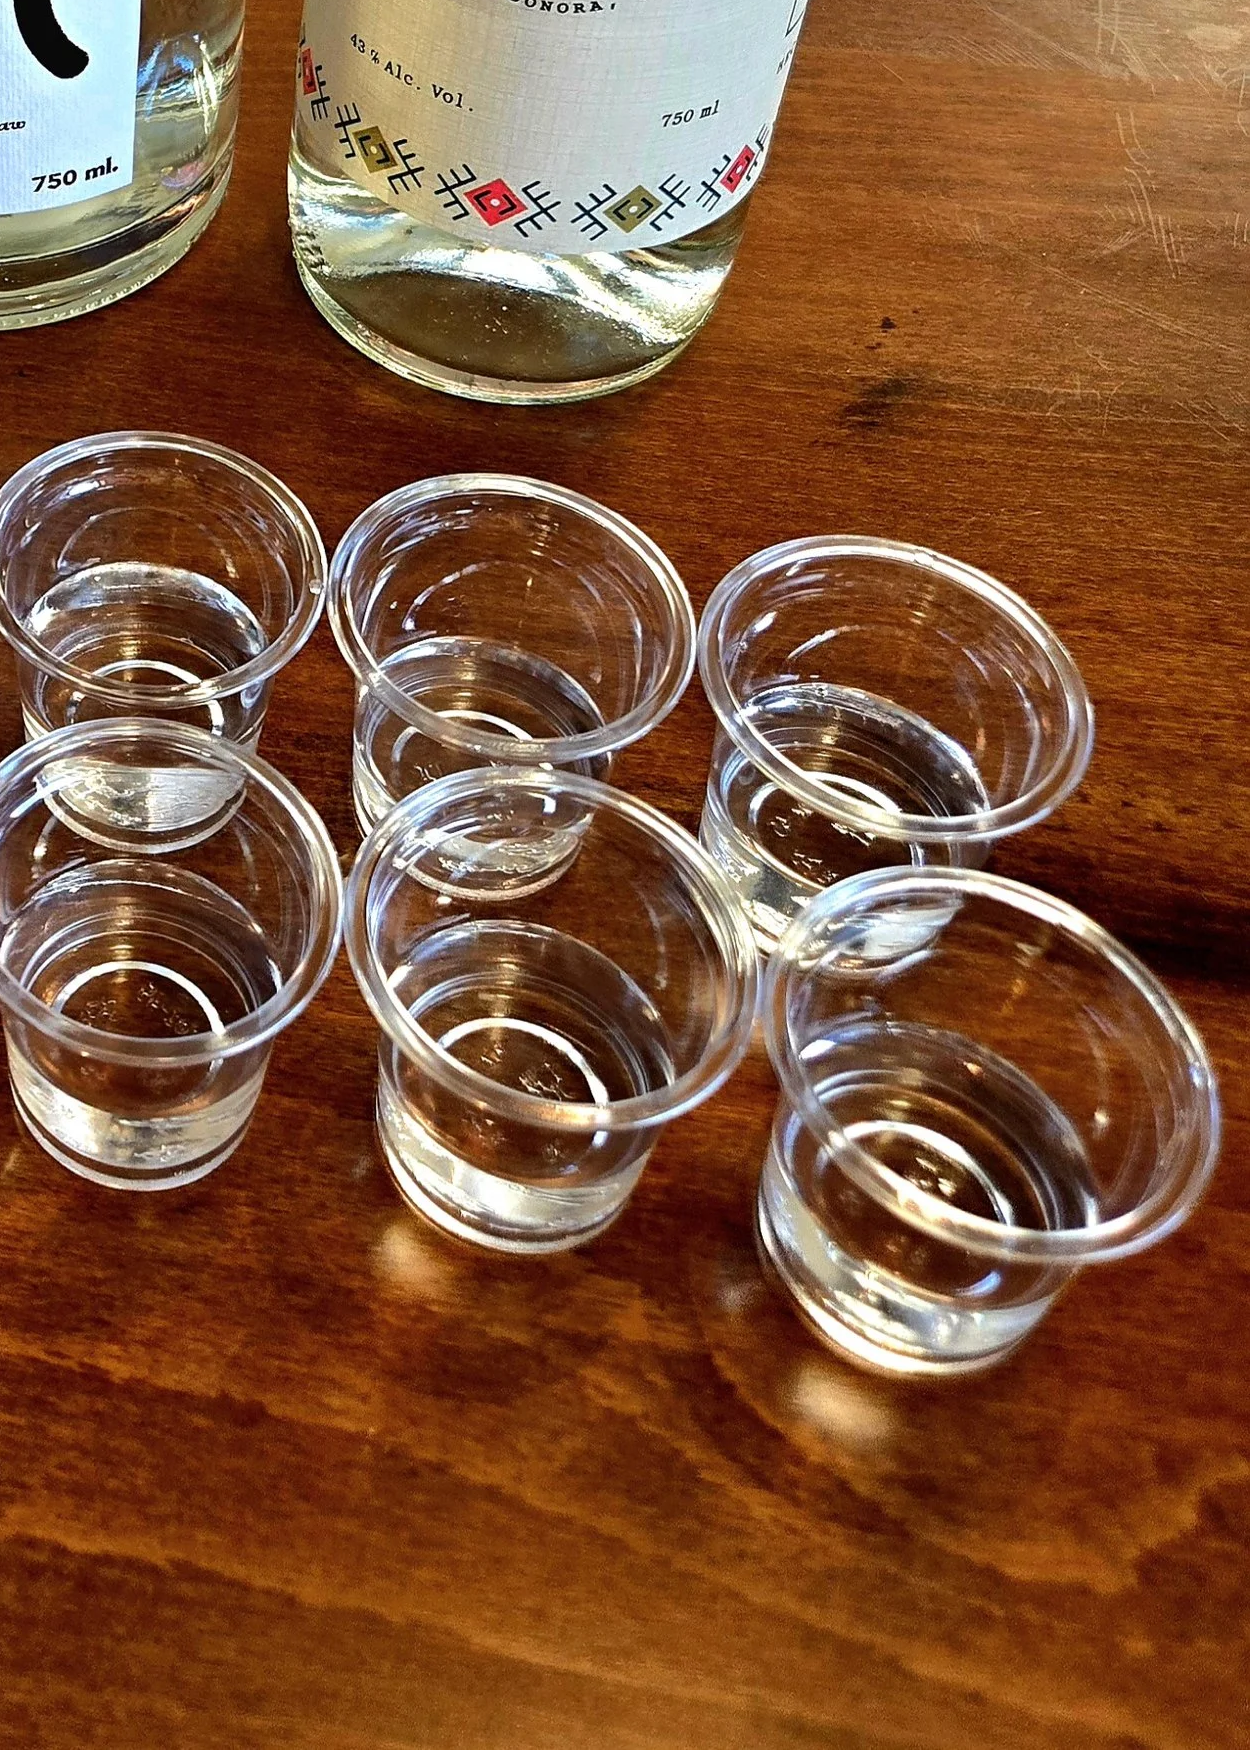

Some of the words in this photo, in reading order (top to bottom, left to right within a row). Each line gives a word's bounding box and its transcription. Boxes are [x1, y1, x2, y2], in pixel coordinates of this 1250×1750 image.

[383, 60, 421, 91] Alc.
[431, 83, 474, 113] Vol.
[661, 108, 695, 128] 750
[698, 98, 720, 119] ml
[31, 168, 78, 193] 750
[84, 155, 120, 181] ml.
